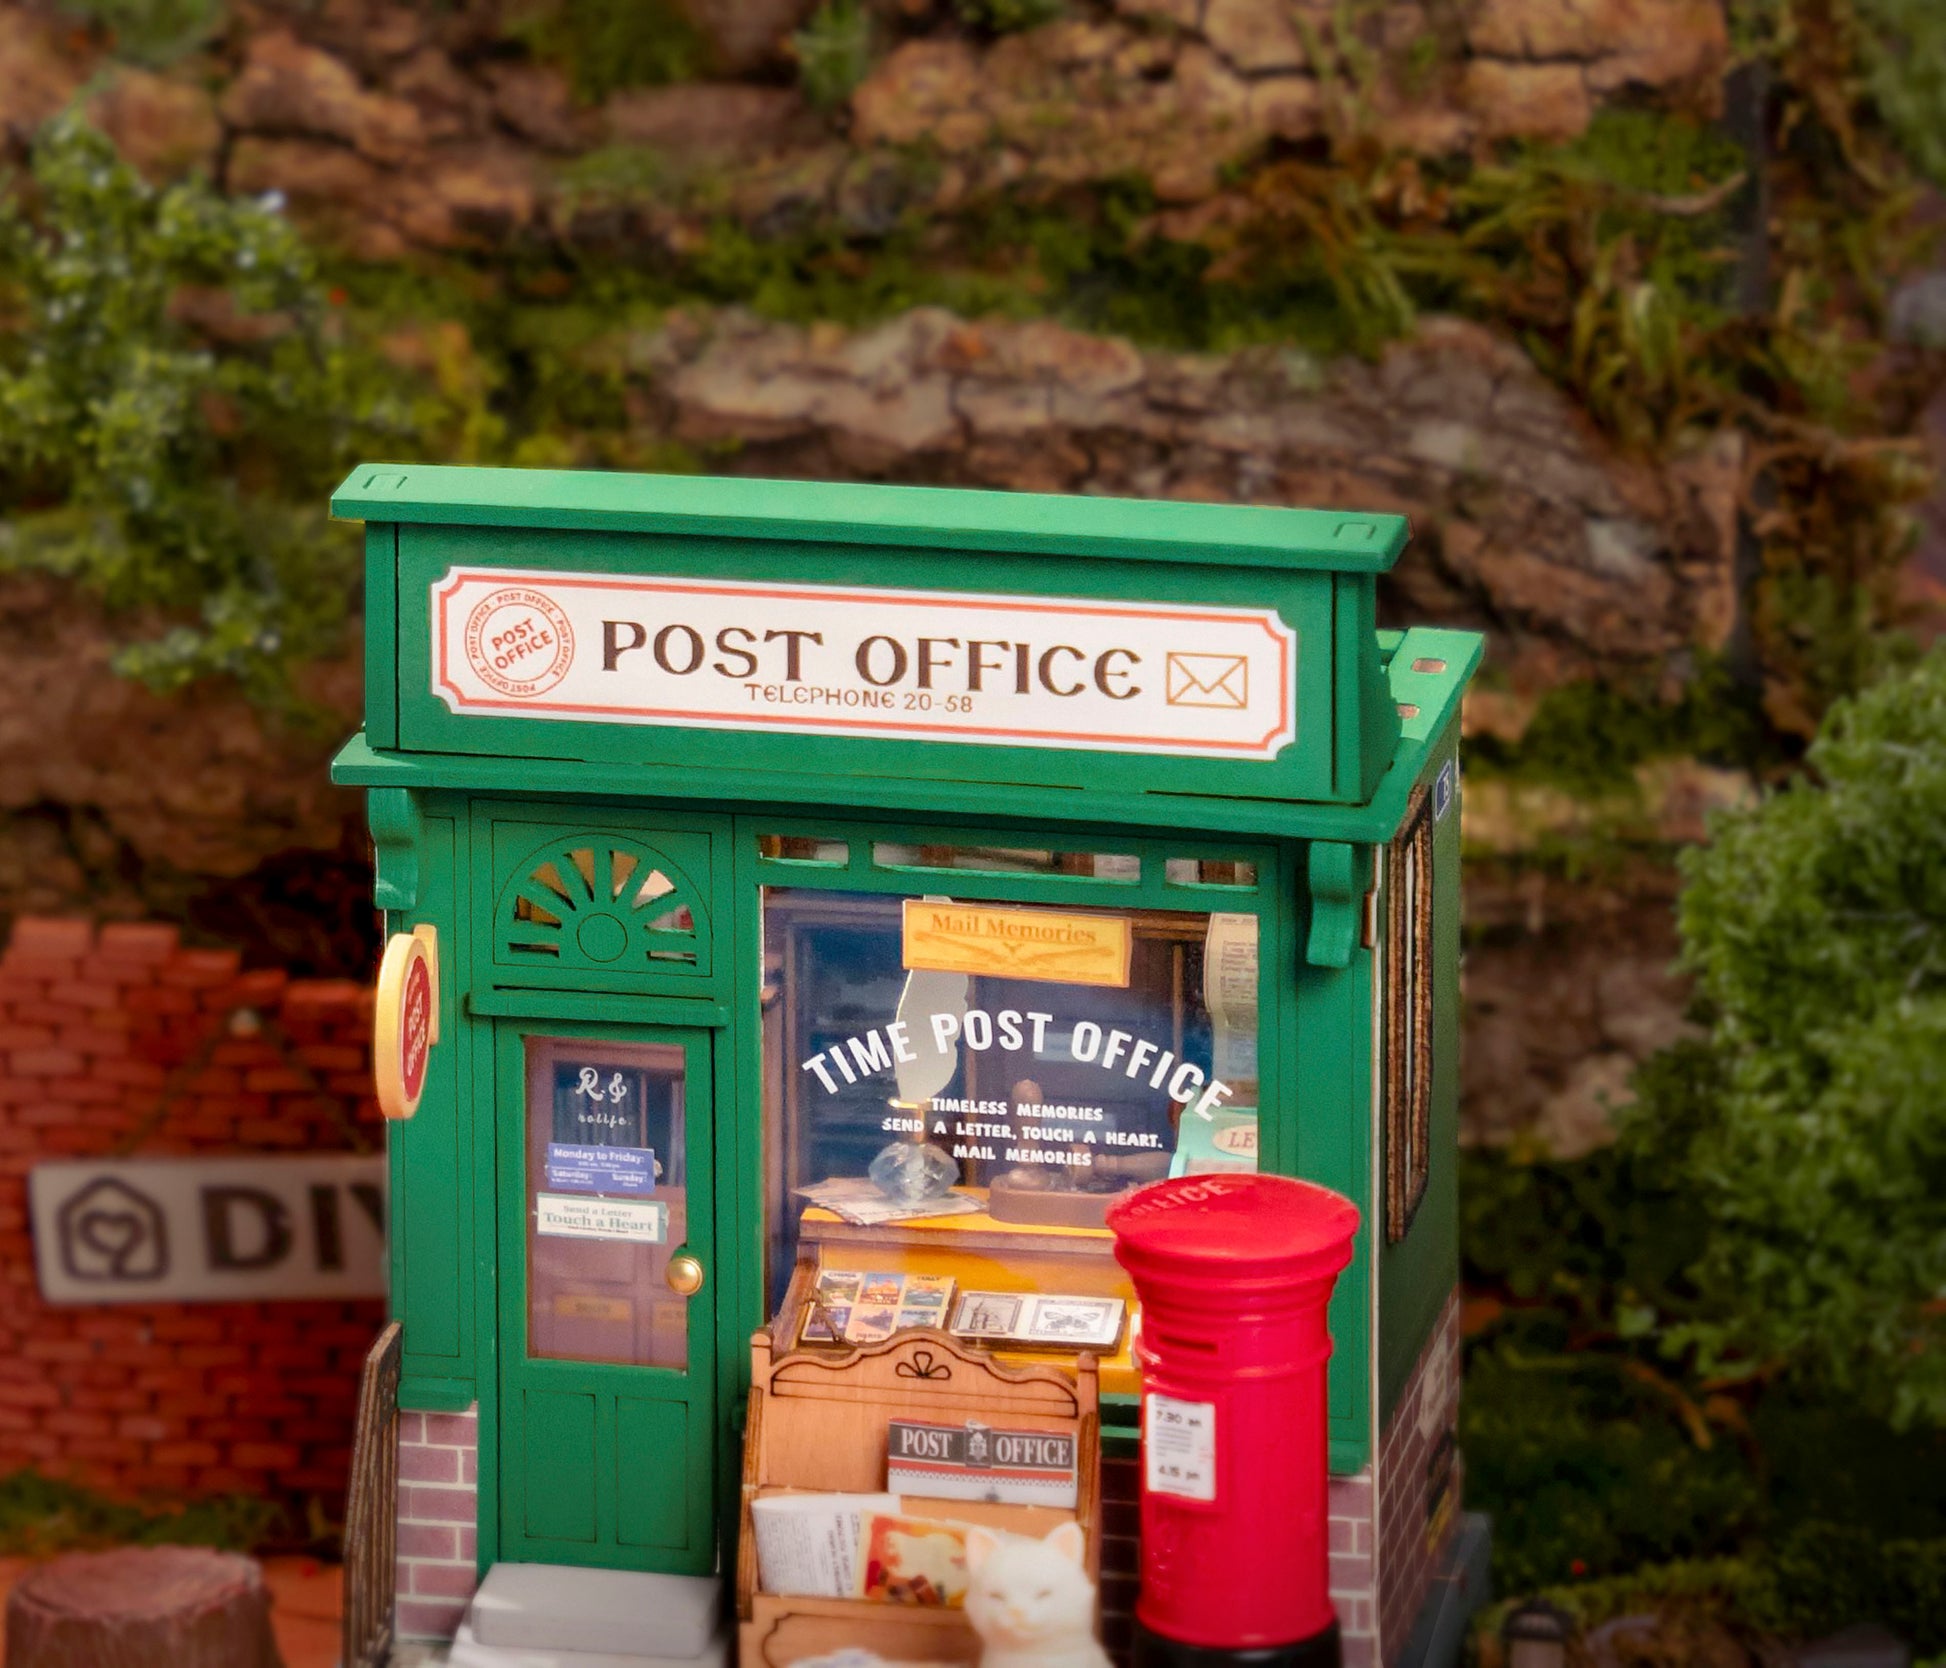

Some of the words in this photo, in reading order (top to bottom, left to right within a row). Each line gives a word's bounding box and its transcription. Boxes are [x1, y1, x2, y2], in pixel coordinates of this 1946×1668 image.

[491, 617, 534, 651] POST
[494, 630, 553, 669] OFFICE
[601, 620, 824, 682] POST
[855, 635, 1143, 700] OFFICE
[744, 683, 895, 709] TELEPHONE
[903, 692, 974, 714] 20-58
[932, 913, 979, 934] Mail
[986, 918, 1097, 944] Memories
[802, 1021, 917, 1095] TIME
[930, 1009, 1054, 1054] POST
[1070, 1020, 1234, 1121] OFFICE
[931, 1098, 1008, 1115] TIMELESS
[1016, 1103, 1103, 1121] MEMORIES
[881, 1118, 924, 1132] SEND
[933, 1121, 947, 1134] A
[956, 1123, 1018, 1140] LETTER,
[1022, 1126, 1074, 1143] TOUCH
[1083, 1130, 1097, 1144] A
[1105, 1131, 1163, 1149] HEART.
[553, 1148, 595, 1161] Monday
[597, 1151, 607, 1161] to
[953, 1145, 996, 1161] MAIL
[1005, 1147, 1092, 1166] MEMORIES
[544, 1212, 592, 1227] Touch
[596, 1218, 605, 1228] a
[609, 1217, 653, 1232] Heart
[901, 1428, 953, 1459] POST
[995, 1437, 1070, 1466] OFFICE
